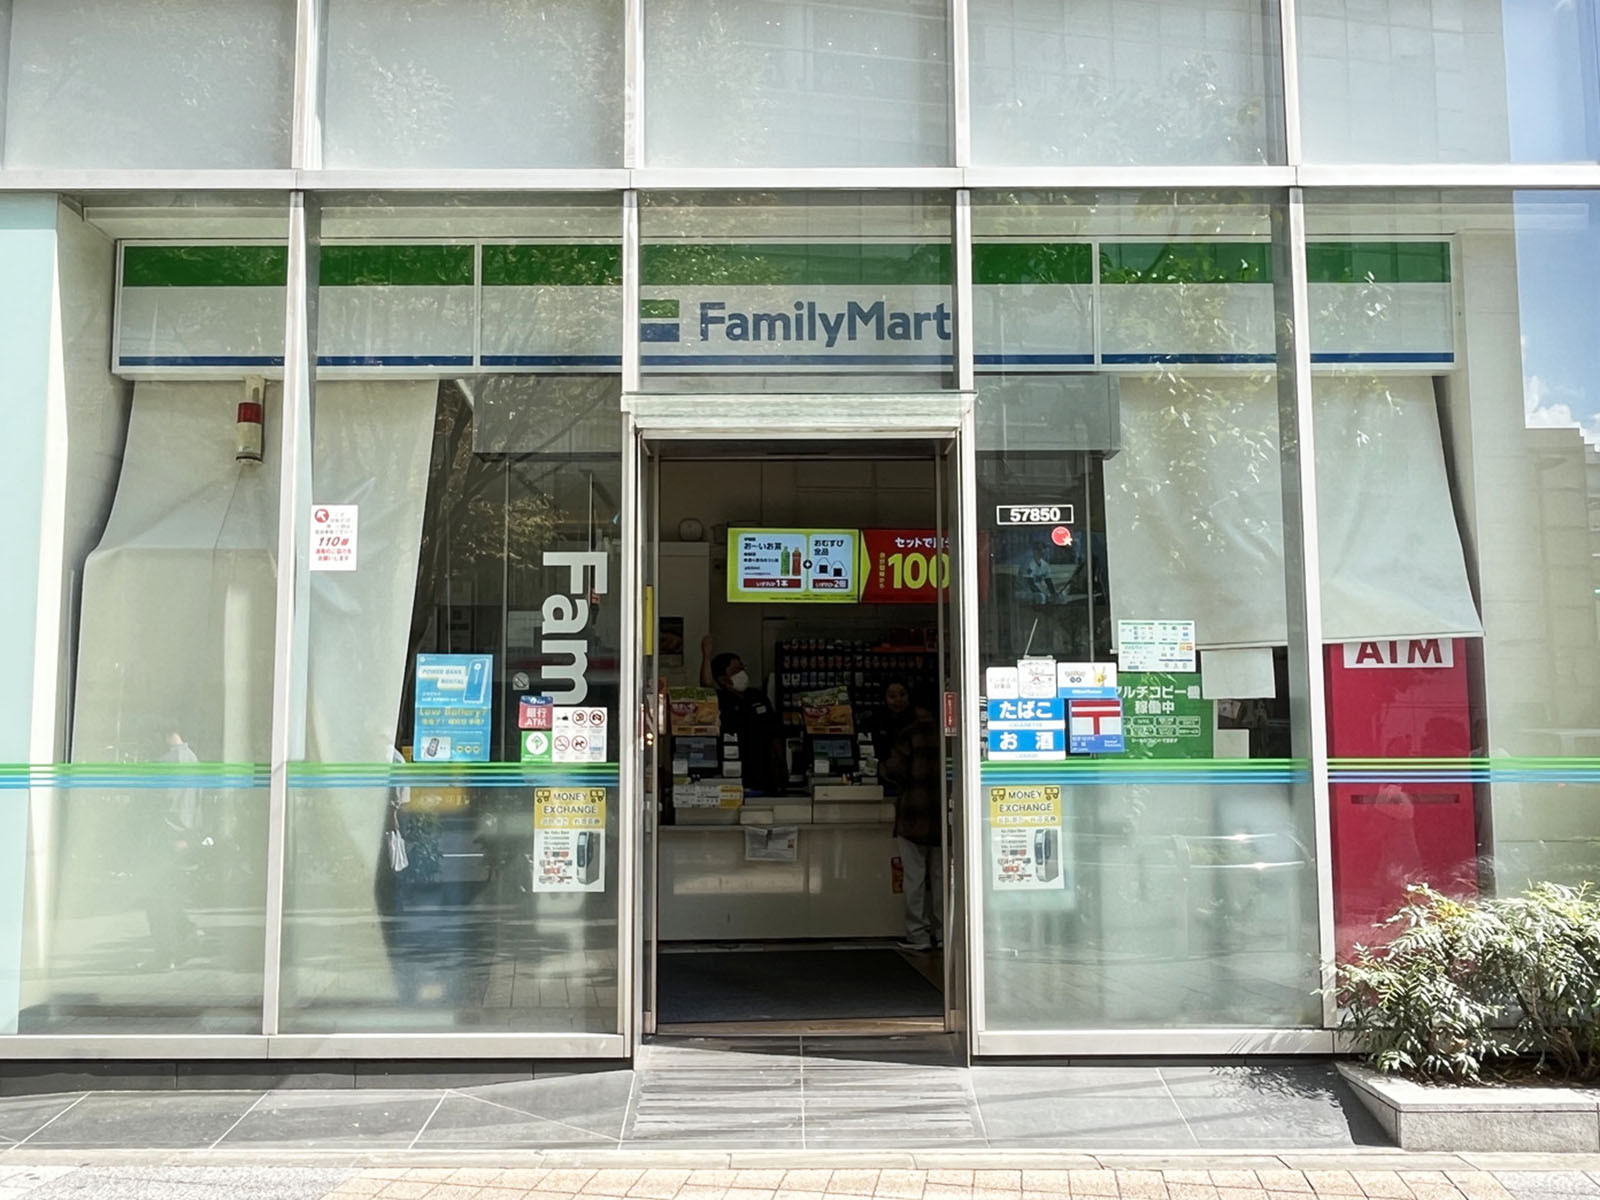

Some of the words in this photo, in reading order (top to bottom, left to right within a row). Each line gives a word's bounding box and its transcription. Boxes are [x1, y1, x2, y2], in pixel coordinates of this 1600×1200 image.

[700, 301, 951, 348] FamilyMart
[1009, 507, 1061, 522] 57850
[813, 539, 844, 547] おむすび
[813, 547, 830, 556] 全品
[541, 552, 608, 705] Fam
[526, 707, 547, 718] 銀行
[999, 701, 1053, 719] たばこ
[526, 718, 547, 726] ATM
[553, 792, 588, 801] MONEY
[1008, 790, 1042, 799] MONEY
[543, 805, 597, 814] EXCHANGE
[999, 803, 1053, 812] EXCHANGE
